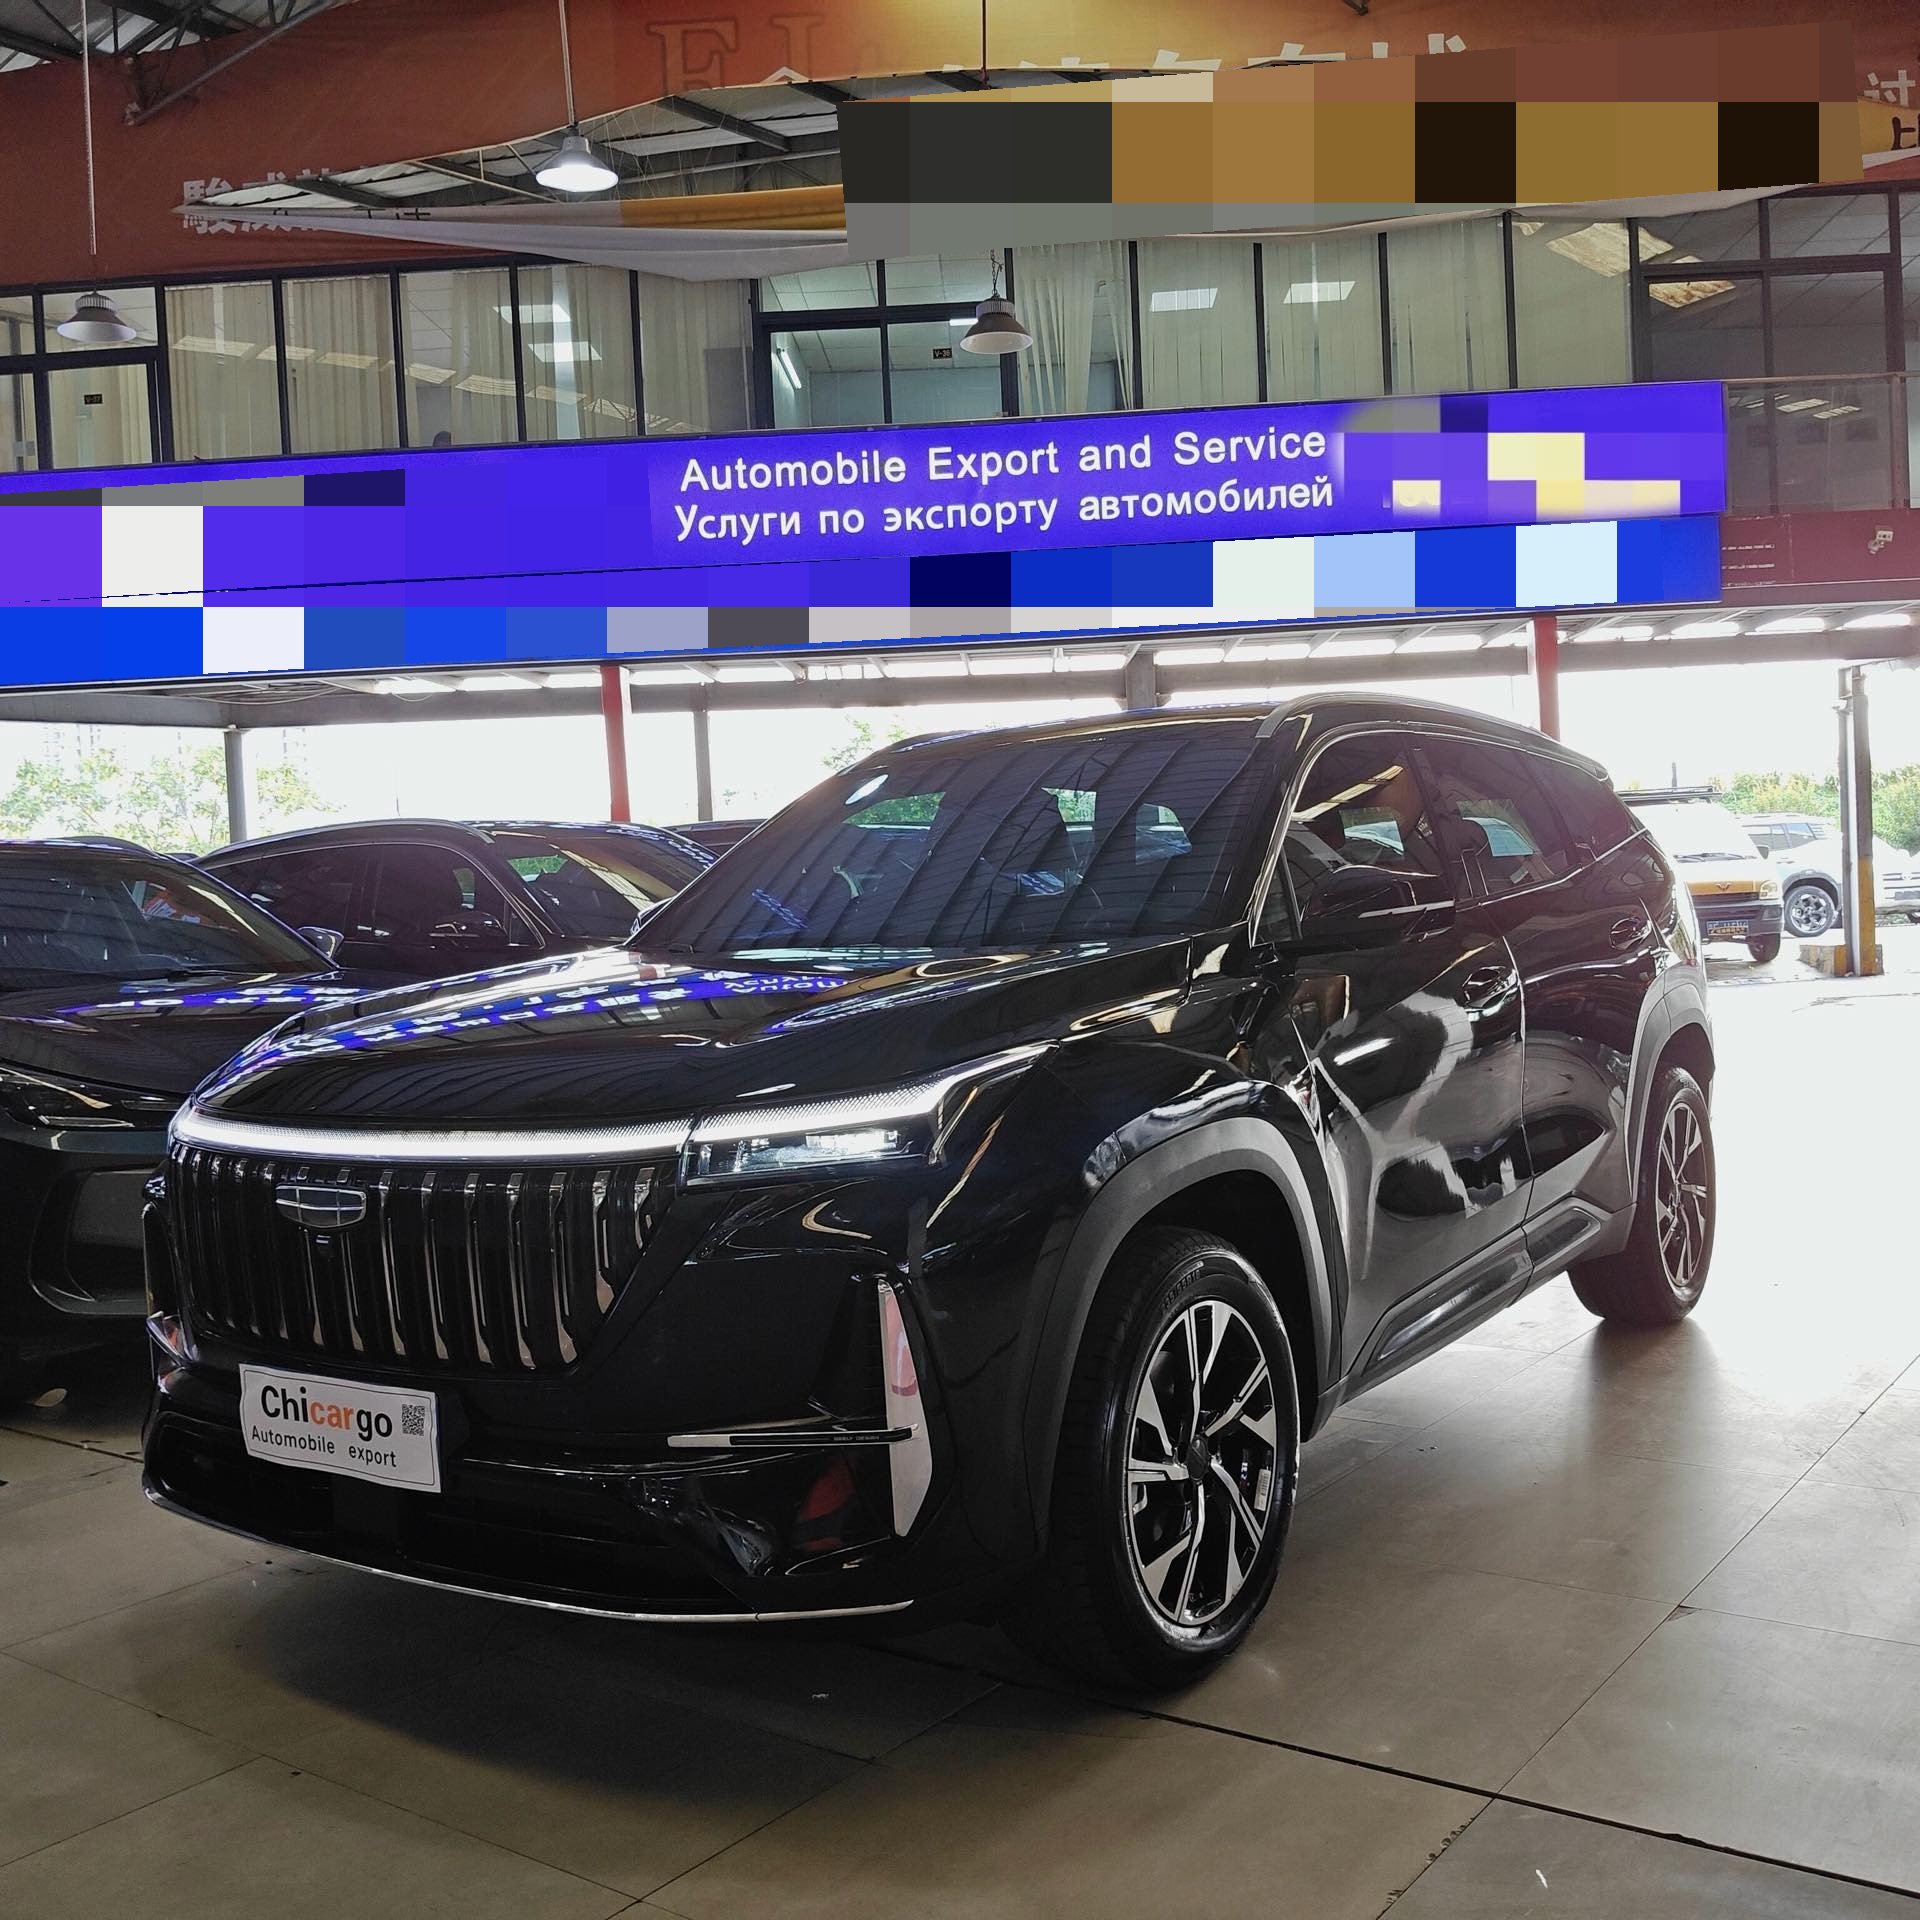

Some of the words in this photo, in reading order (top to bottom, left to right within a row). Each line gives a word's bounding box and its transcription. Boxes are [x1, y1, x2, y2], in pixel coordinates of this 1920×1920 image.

[680, 450, 906, 492] Automobile
[928, 441, 1059, 486] Export
[1079, 434, 1151, 472] and
[1174, 427, 1326, 466] Service
[674, 503, 801, 546] Услуги
[819, 508, 865, 534] по
[883, 498, 1058, 534] экспорту
[1079, 475, 1333, 521] автомобилей
[261, 1385, 393, 1442] Chicargo
[251, 1425, 335, 1454] Automobile
[348, 1445, 397, 1468] export
